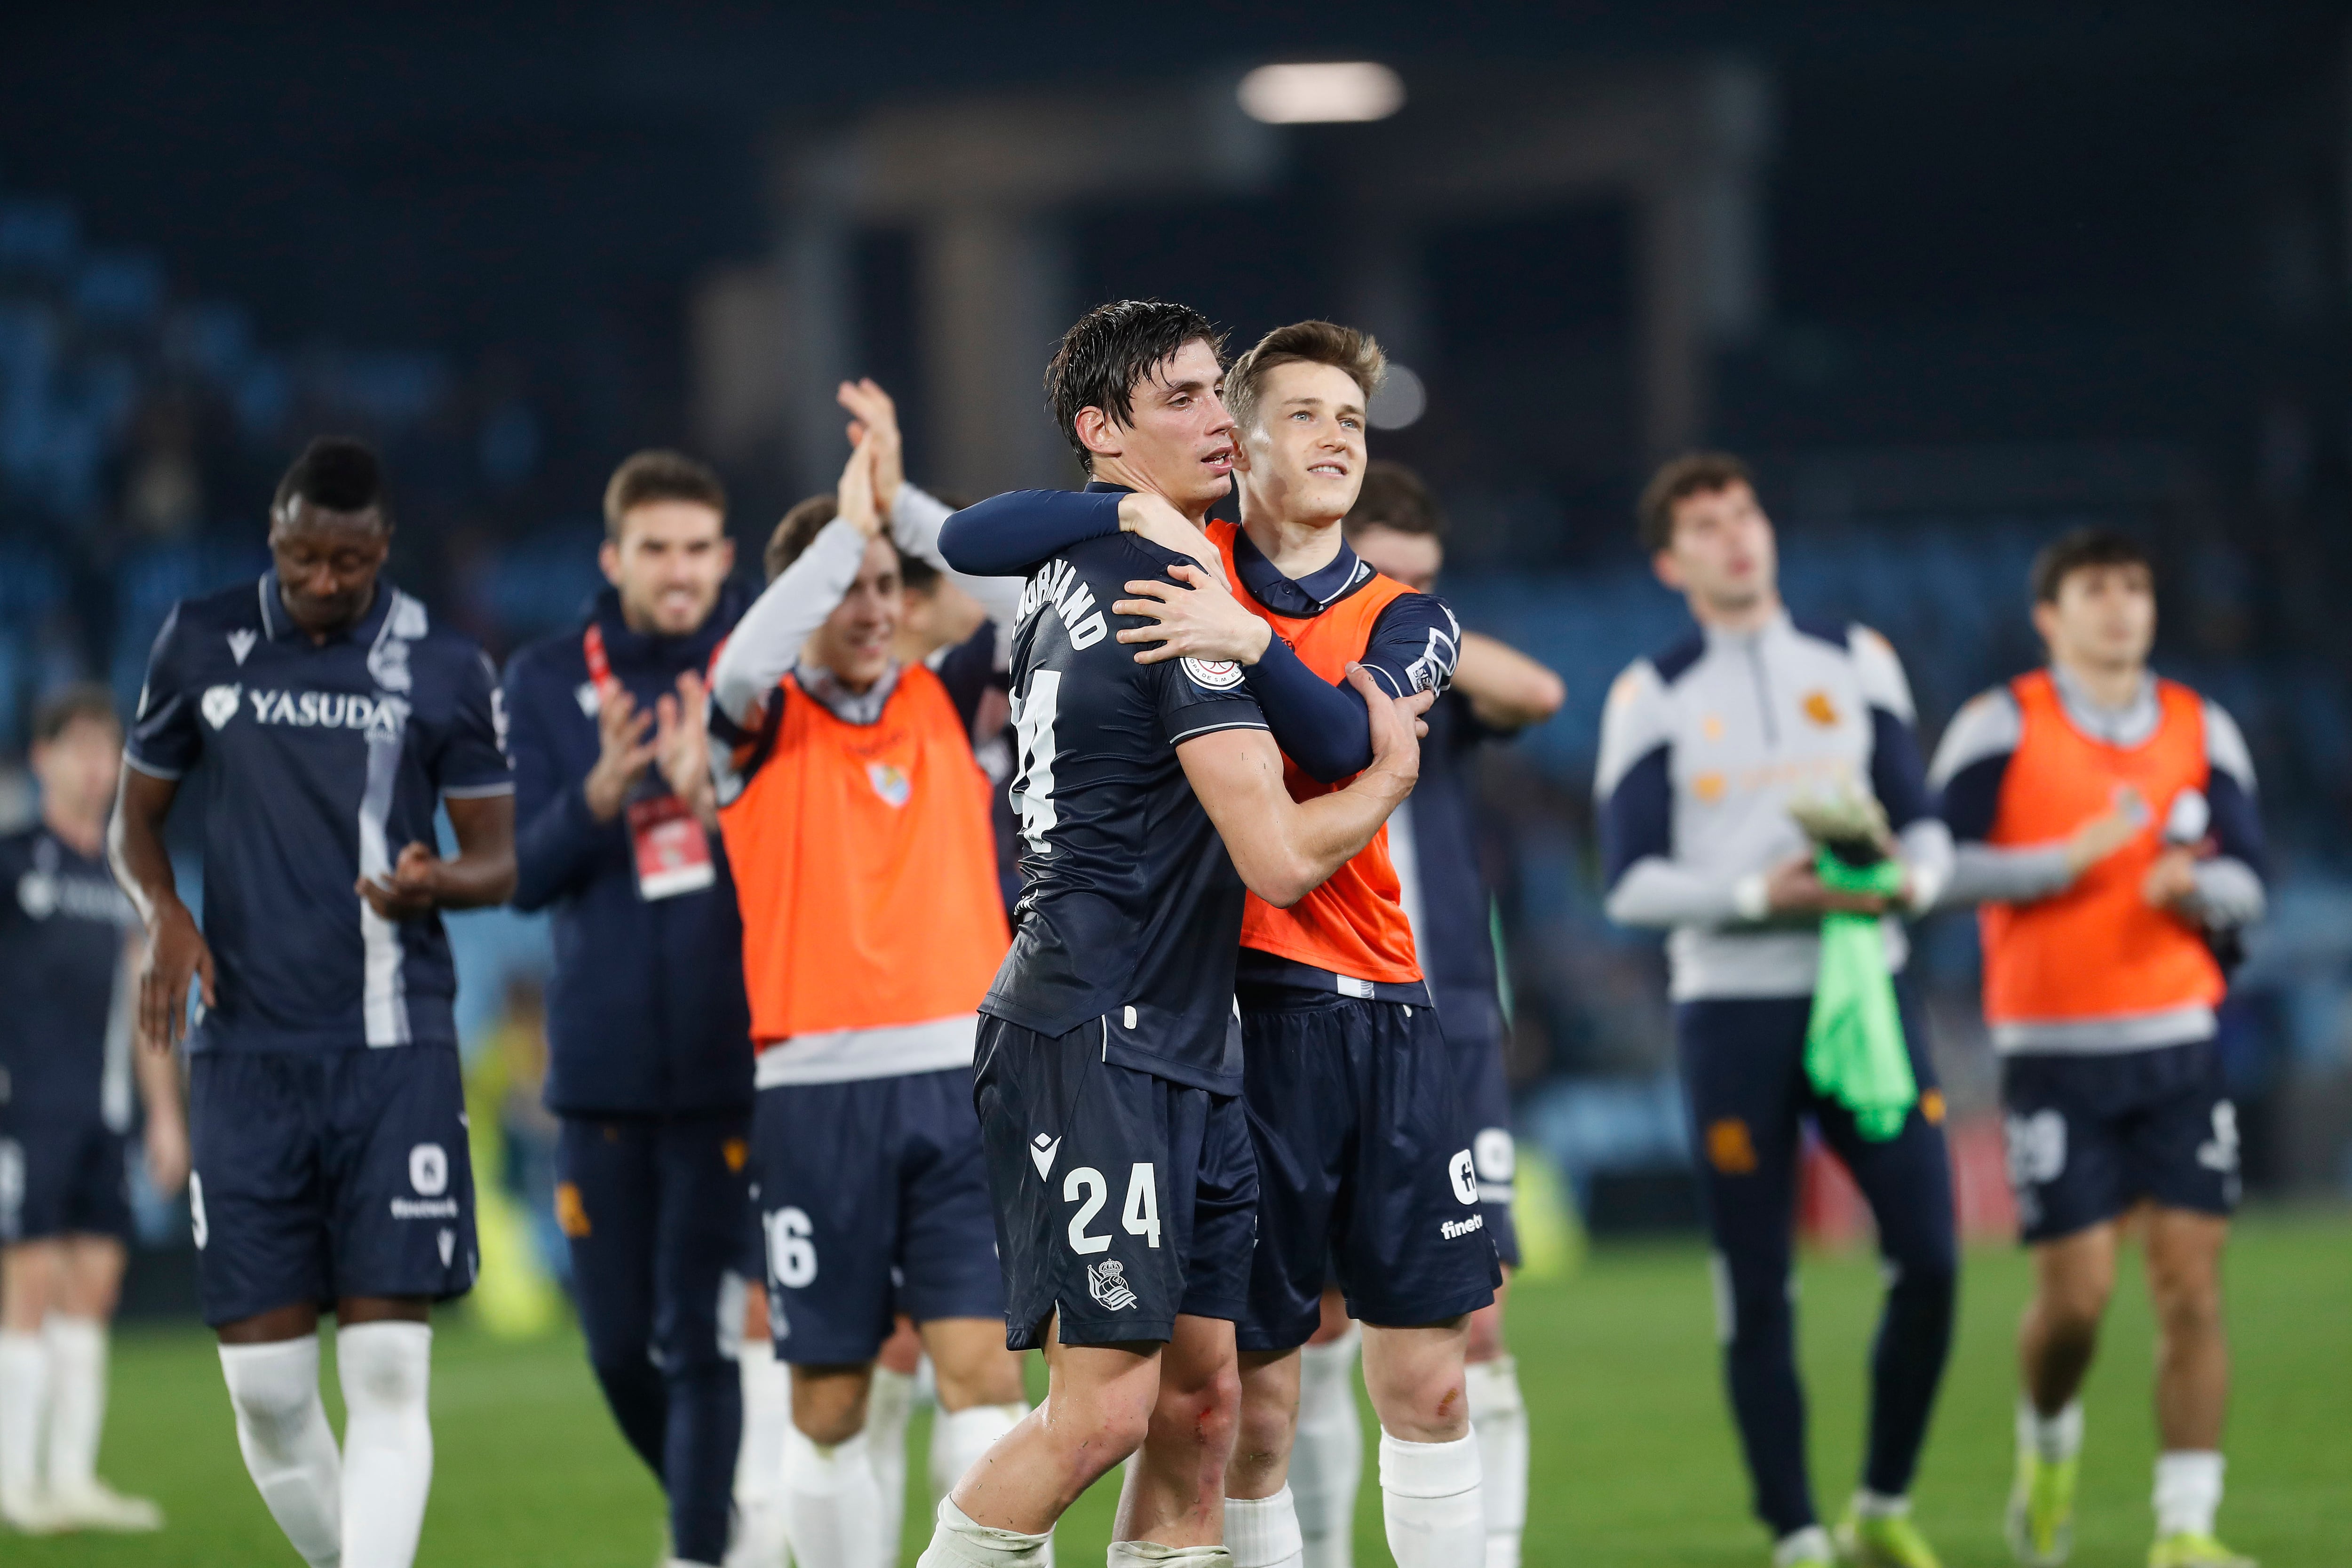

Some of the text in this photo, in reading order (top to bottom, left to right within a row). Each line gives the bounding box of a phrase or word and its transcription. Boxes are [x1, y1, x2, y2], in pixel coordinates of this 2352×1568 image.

[1190, 659, 1200, 674] OPA
[248, 688, 397, 732] YASUDA
[1063, 1162, 1160, 1256] 24
